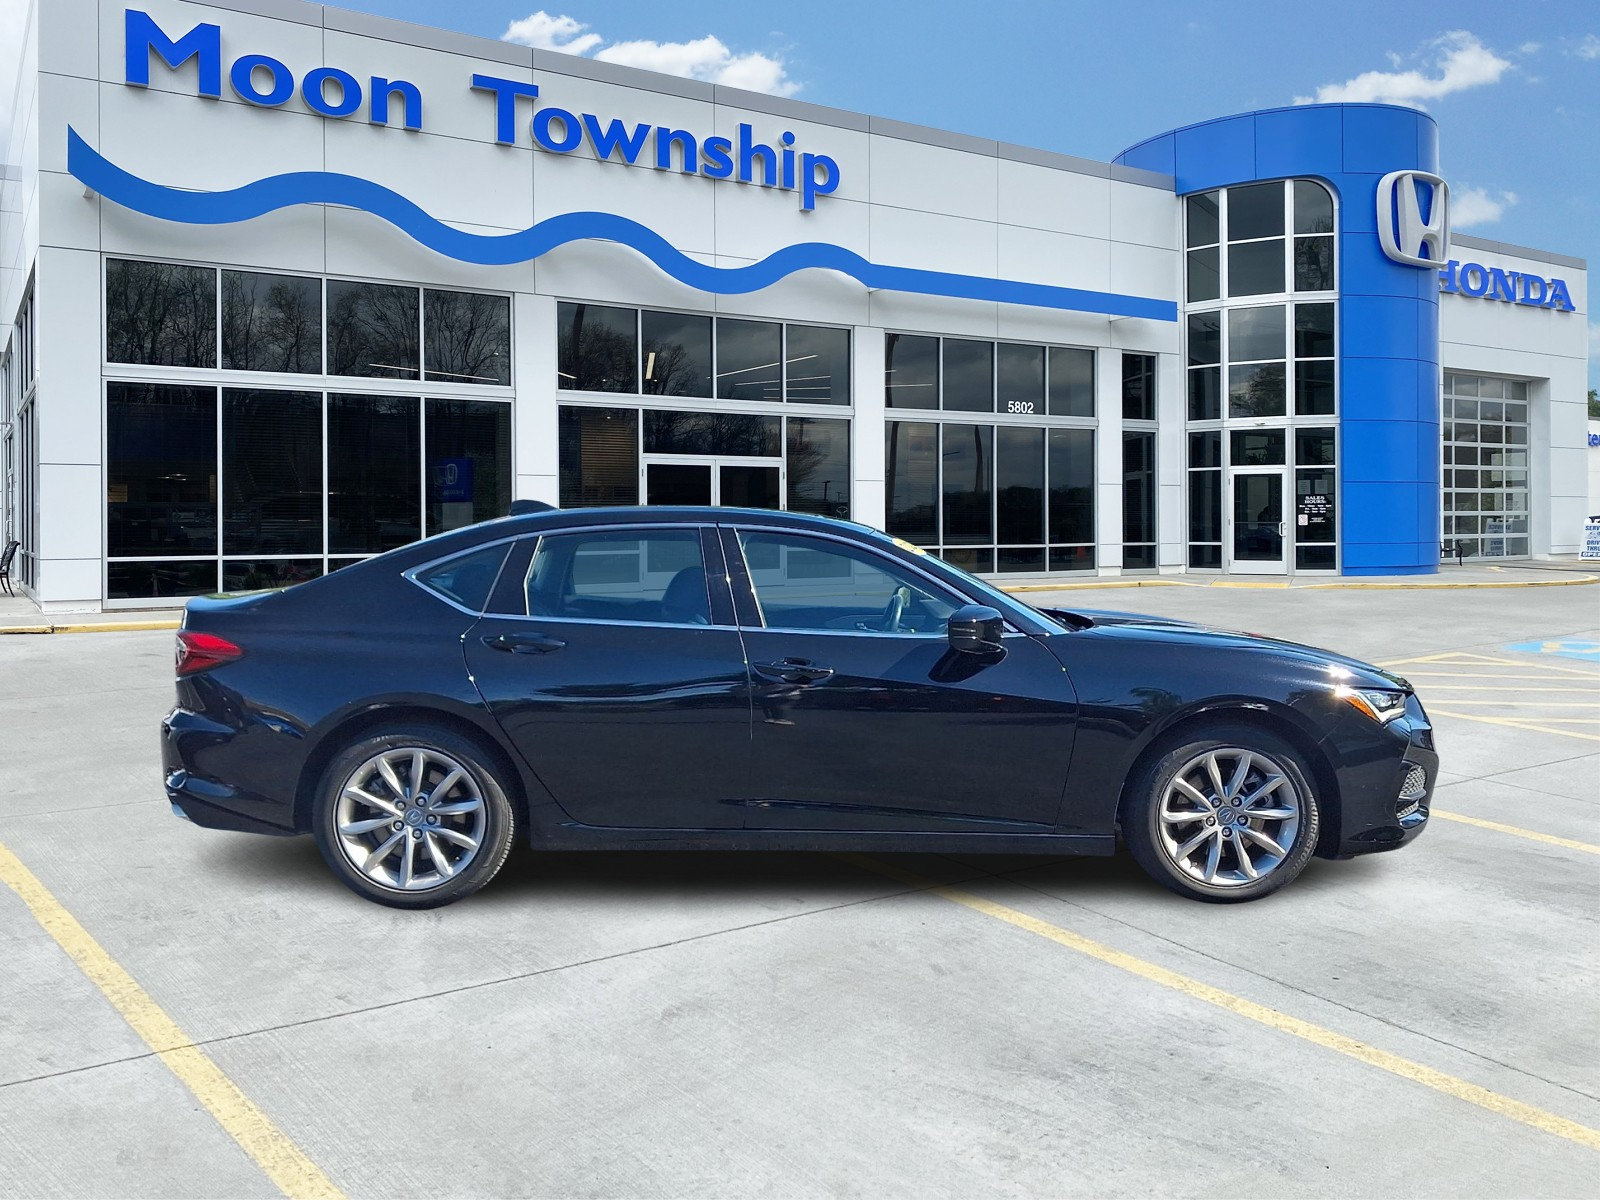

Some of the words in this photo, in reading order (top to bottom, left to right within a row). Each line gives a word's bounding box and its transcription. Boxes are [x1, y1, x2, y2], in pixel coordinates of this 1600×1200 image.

[125, 8, 422, 132] Moon
[469, 73, 840, 213] Township
[1439, 259, 1576, 312] HONDA
[1007, 400, 1034, 414] 5802
